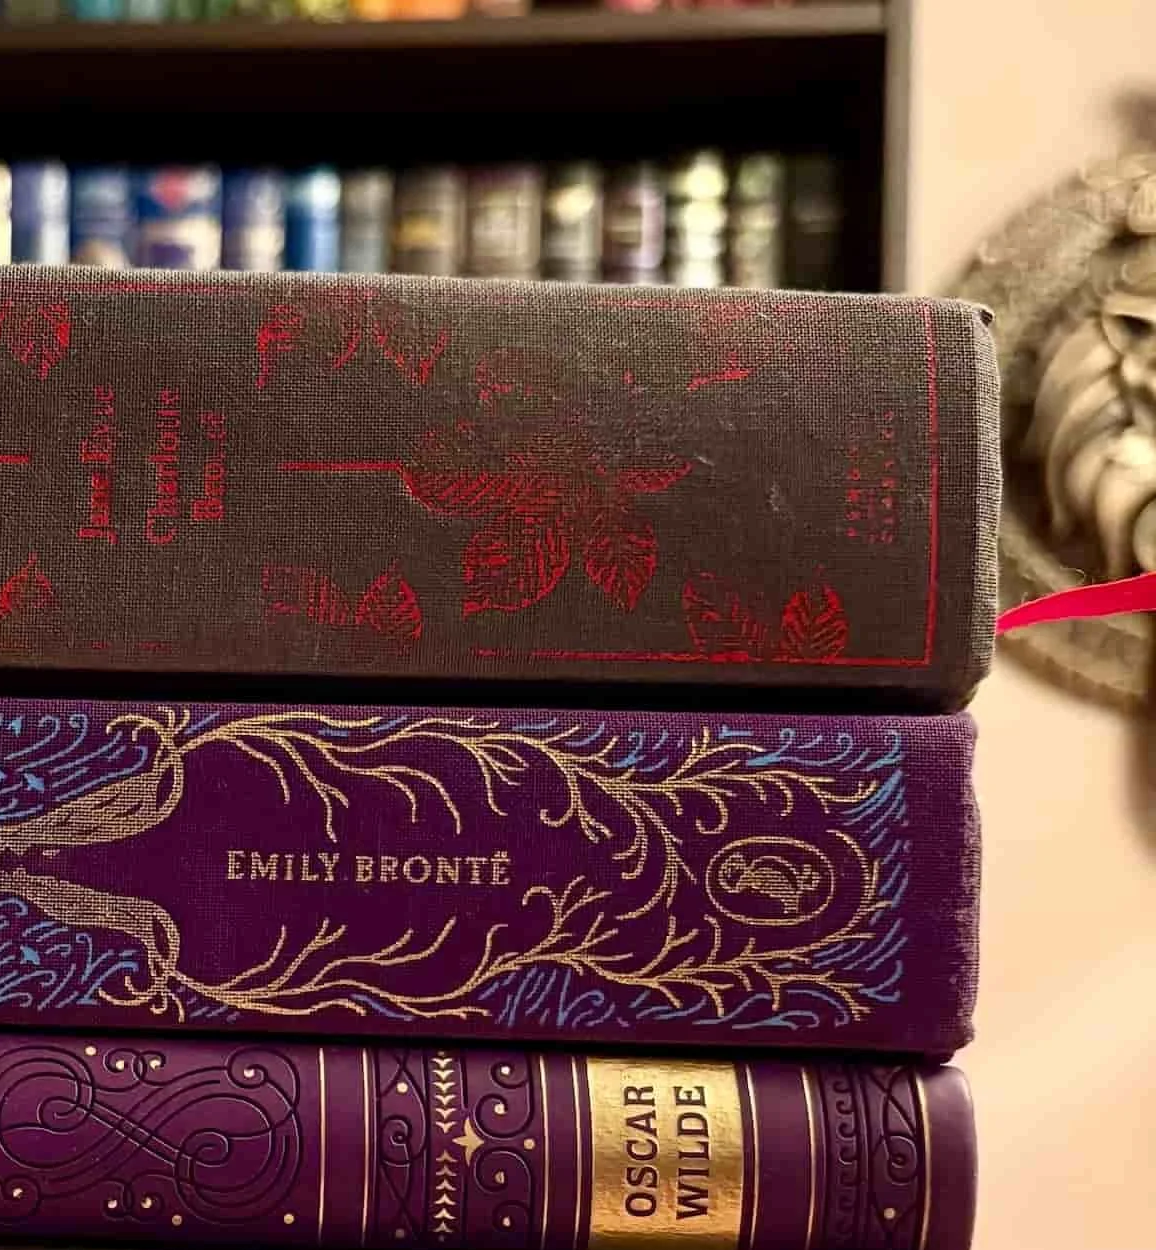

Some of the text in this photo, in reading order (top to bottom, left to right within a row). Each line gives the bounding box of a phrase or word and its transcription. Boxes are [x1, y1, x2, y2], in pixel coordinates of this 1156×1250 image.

[76, 472, 119, 544] Jane
[226, 850, 511, 885] EMILY BRONTË
[624, 1086, 658, 1217] OSCAR
[674, 1086, 709, 1220] WILDE
